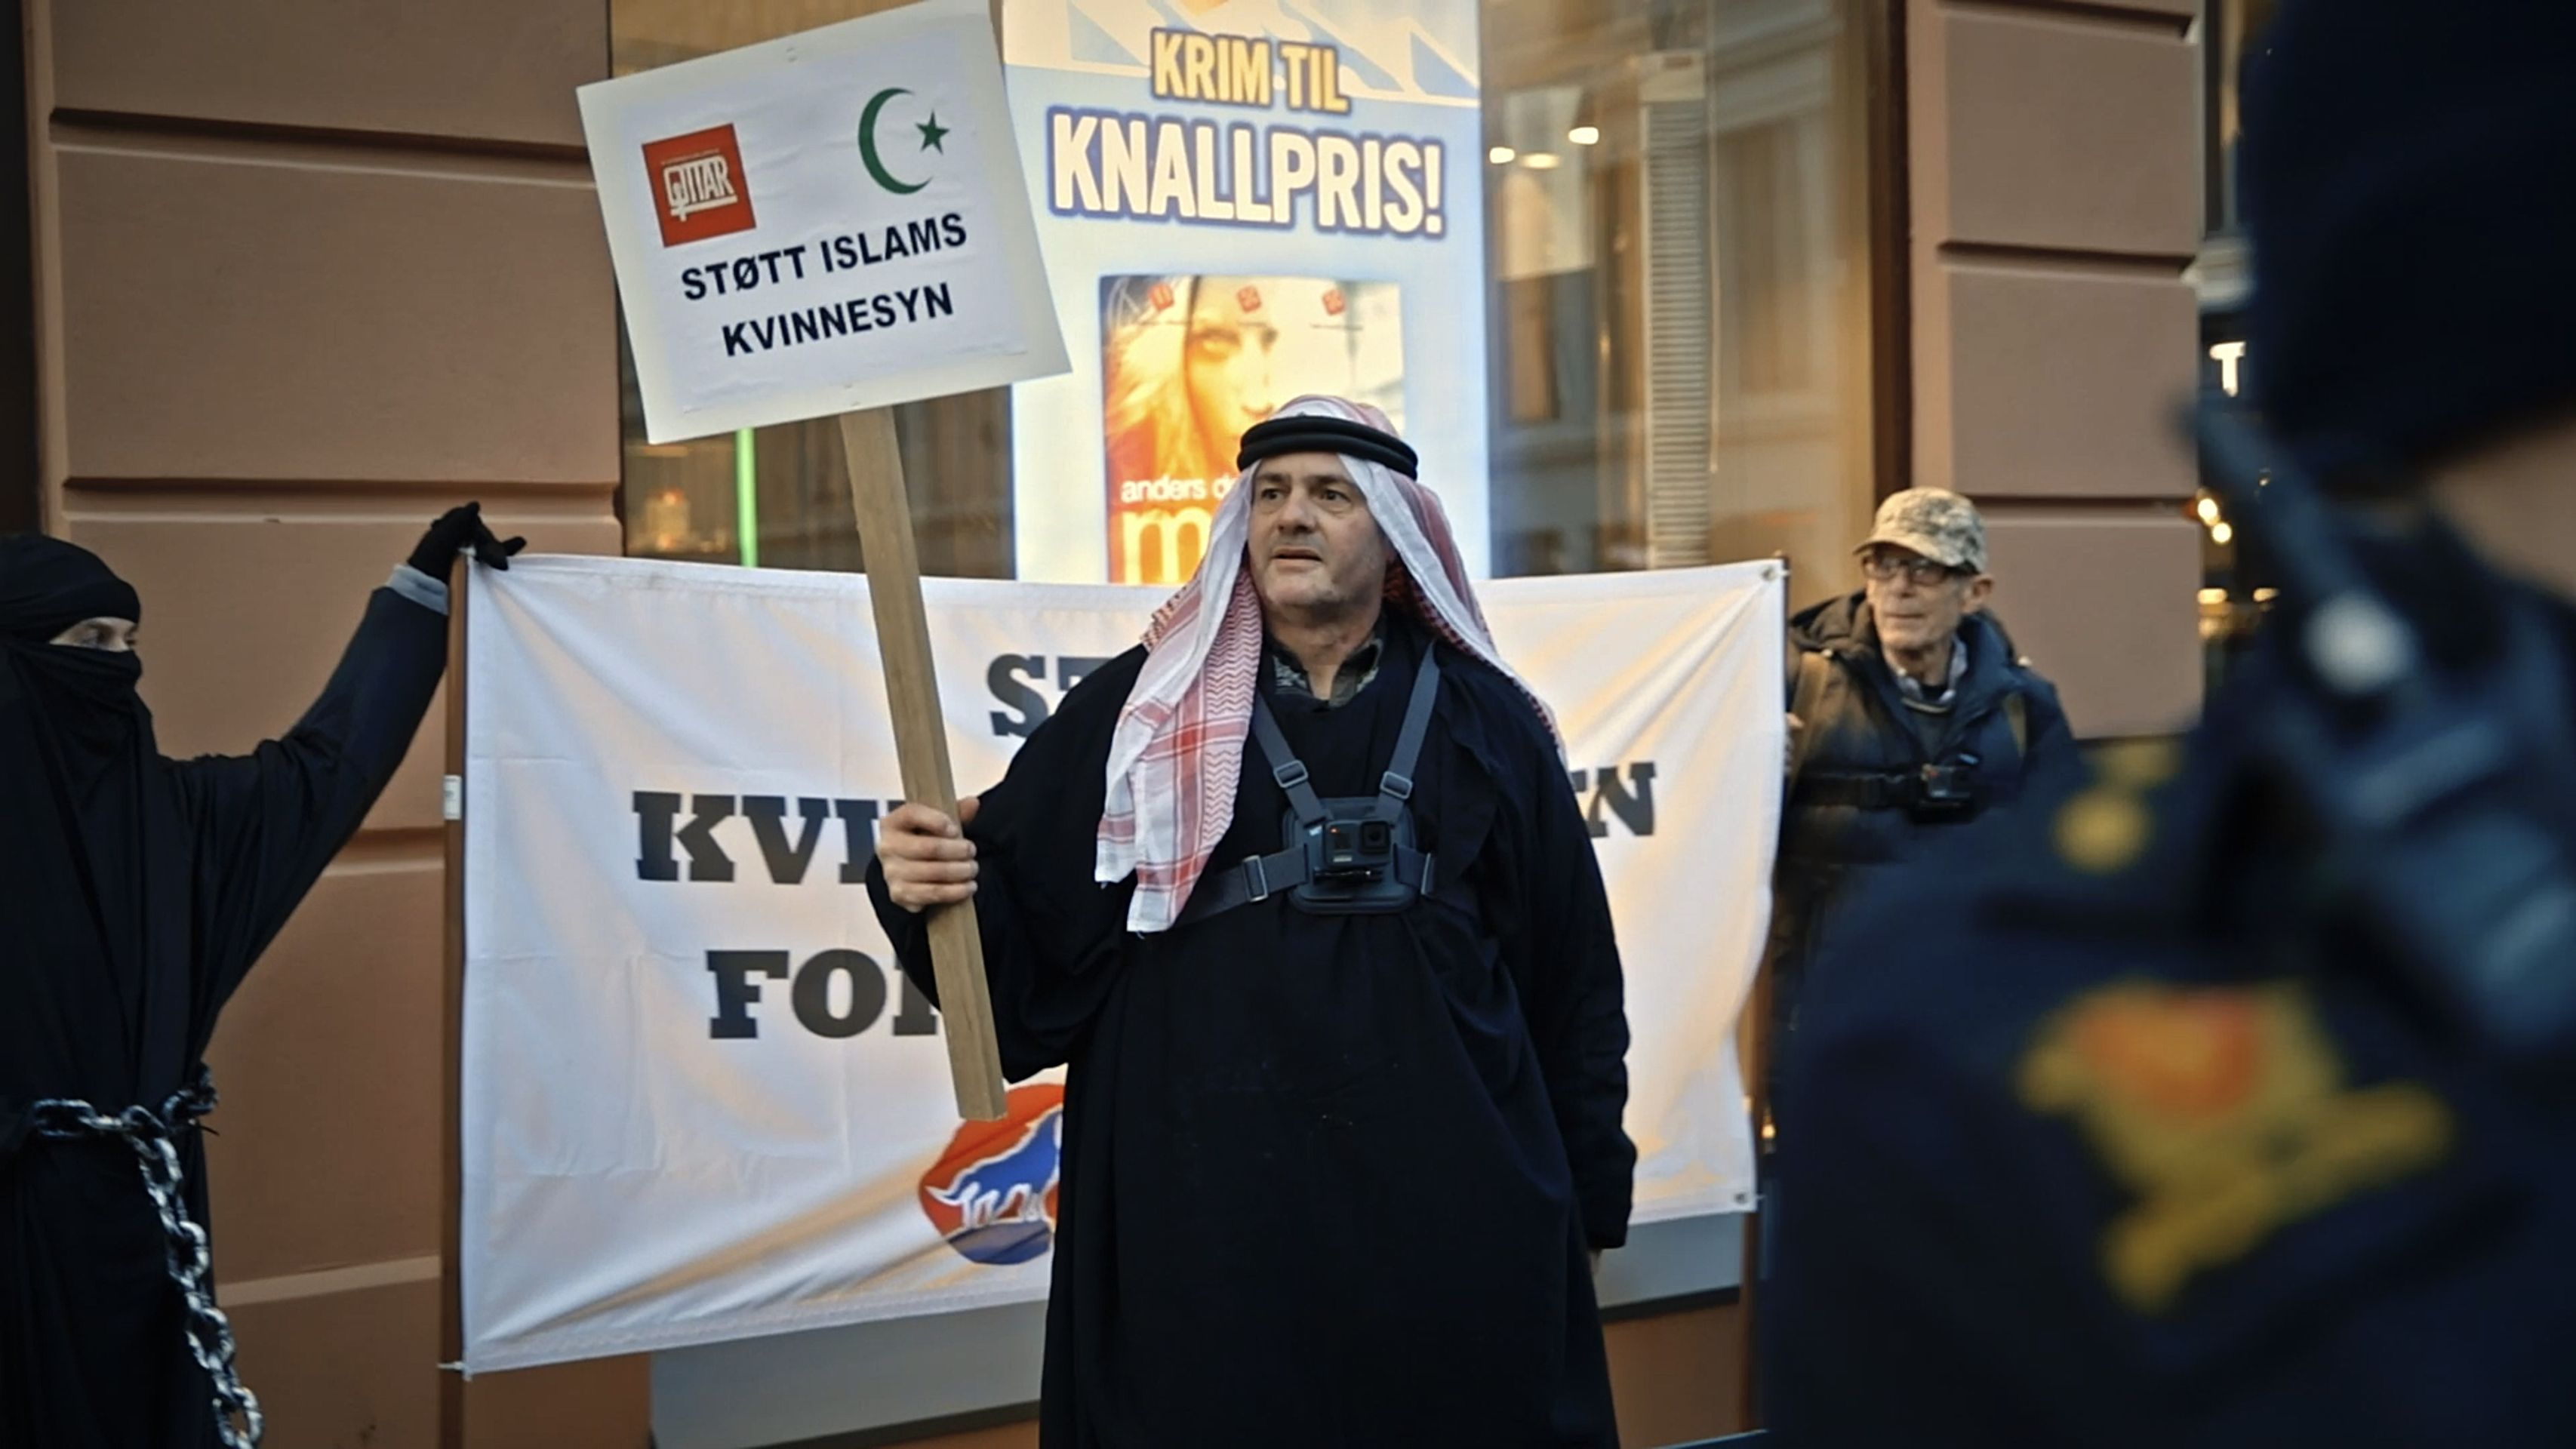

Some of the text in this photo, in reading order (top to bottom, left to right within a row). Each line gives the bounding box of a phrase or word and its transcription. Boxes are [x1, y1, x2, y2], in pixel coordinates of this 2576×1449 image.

[1152, 29, 1350, 112] KRIM TIL
[1050, 110, 1444, 235] KNALLPRIS!
[682, 213, 968, 300] STØTT ISLAMS
[722, 282, 954, 357] KVINNESYN
[1121, 474, 1207, 503] anders
[632, 791, 907, 884] KVI
